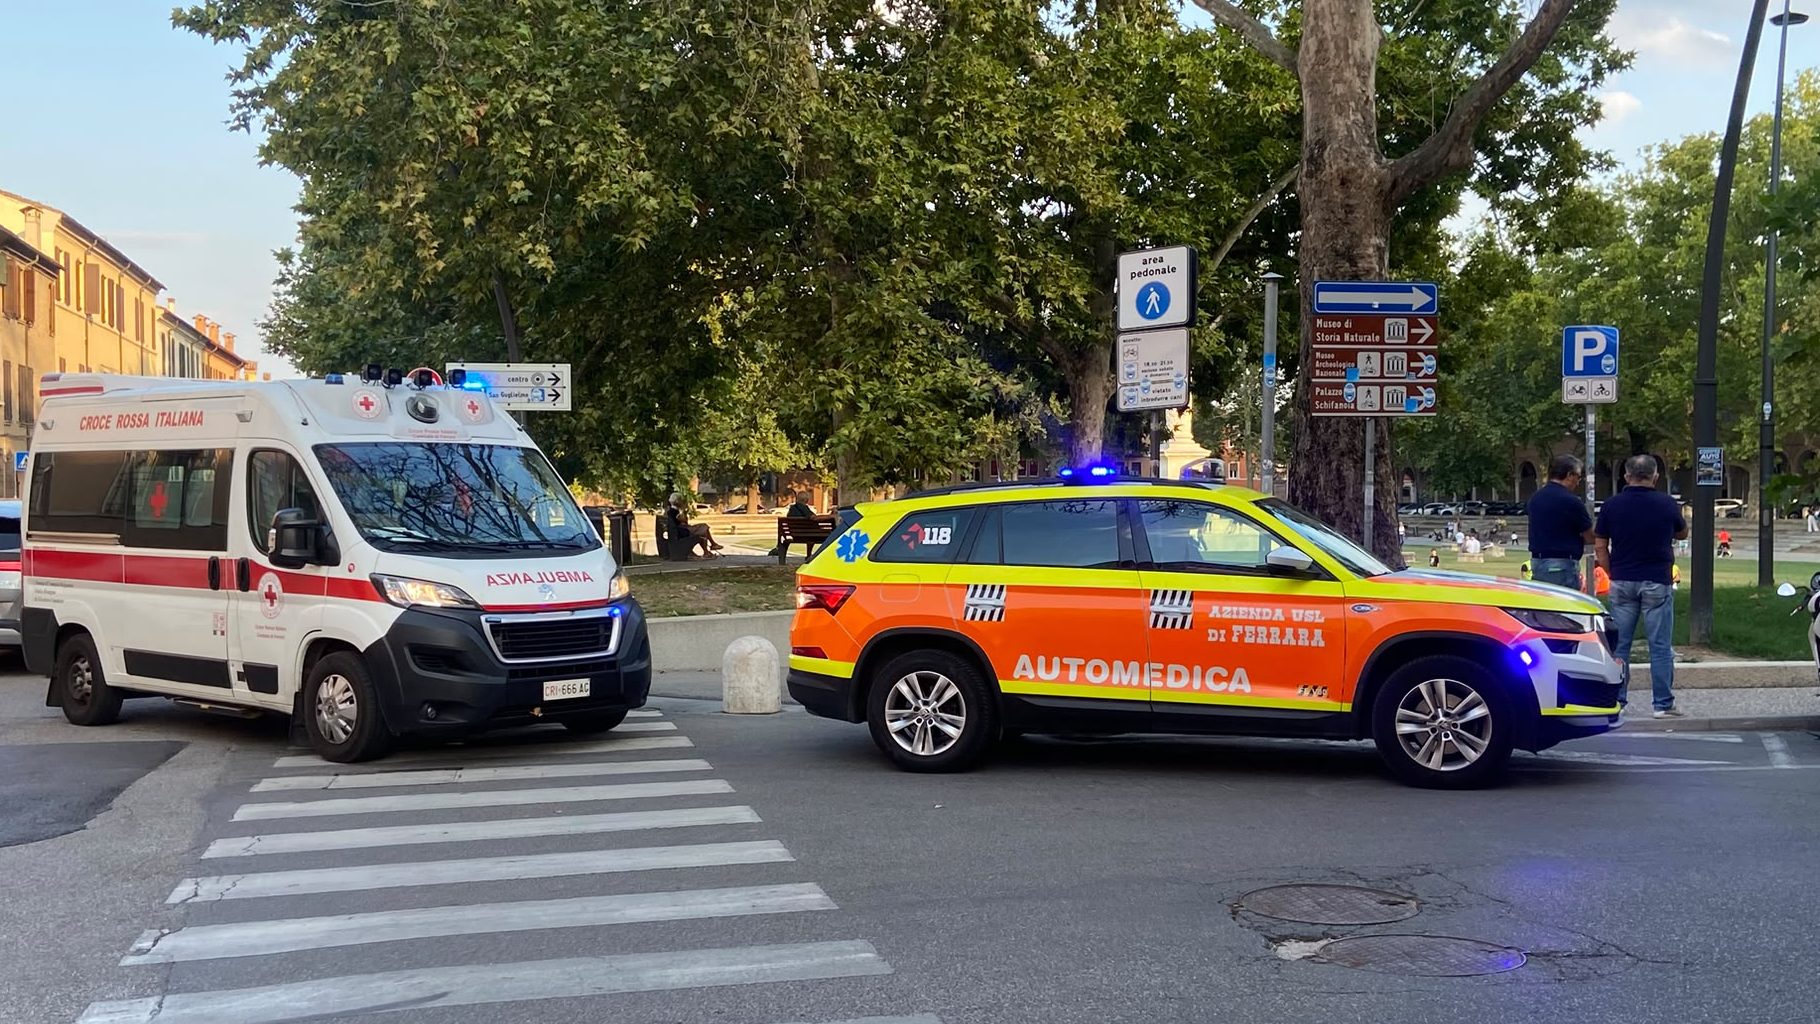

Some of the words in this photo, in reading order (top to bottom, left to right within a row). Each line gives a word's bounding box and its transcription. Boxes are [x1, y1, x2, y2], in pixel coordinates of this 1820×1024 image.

[1142, 256, 1164, 266] area
[1130, 265, 1177, 280] pedonale
[1316, 318, 1341, 328] Museo
[1344, 318, 1352, 328] di
[1316, 332, 1341, 342] Storia
[1344, 332, 1380, 342] Naturale
[1574, 331, 1607, 371] P
[1316, 361, 1355, 369] Archeologico
[1316, 369, 1346, 377] Nazionale
[507, 375, 529, 383] centro
[1315, 387, 1343, 396] Palazzo
[1315, 401, 1355, 409] Schifanoia
[80, 415, 112, 430] CROCE
[116, 413, 150, 429] ROSSA
[155, 410, 204, 427] ITALIANA
[922, 527, 952, 545] 118
[1208, 605, 1285, 621] AZIENDA
[1291, 609, 1325, 623] USL
[1231, 625, 1325, 647] FERRARA
[1012, 654, 1252, 693] AUTOMEDICA
[545, 685, 558, 696] CRI
[561, 684, 577, 695] 666
